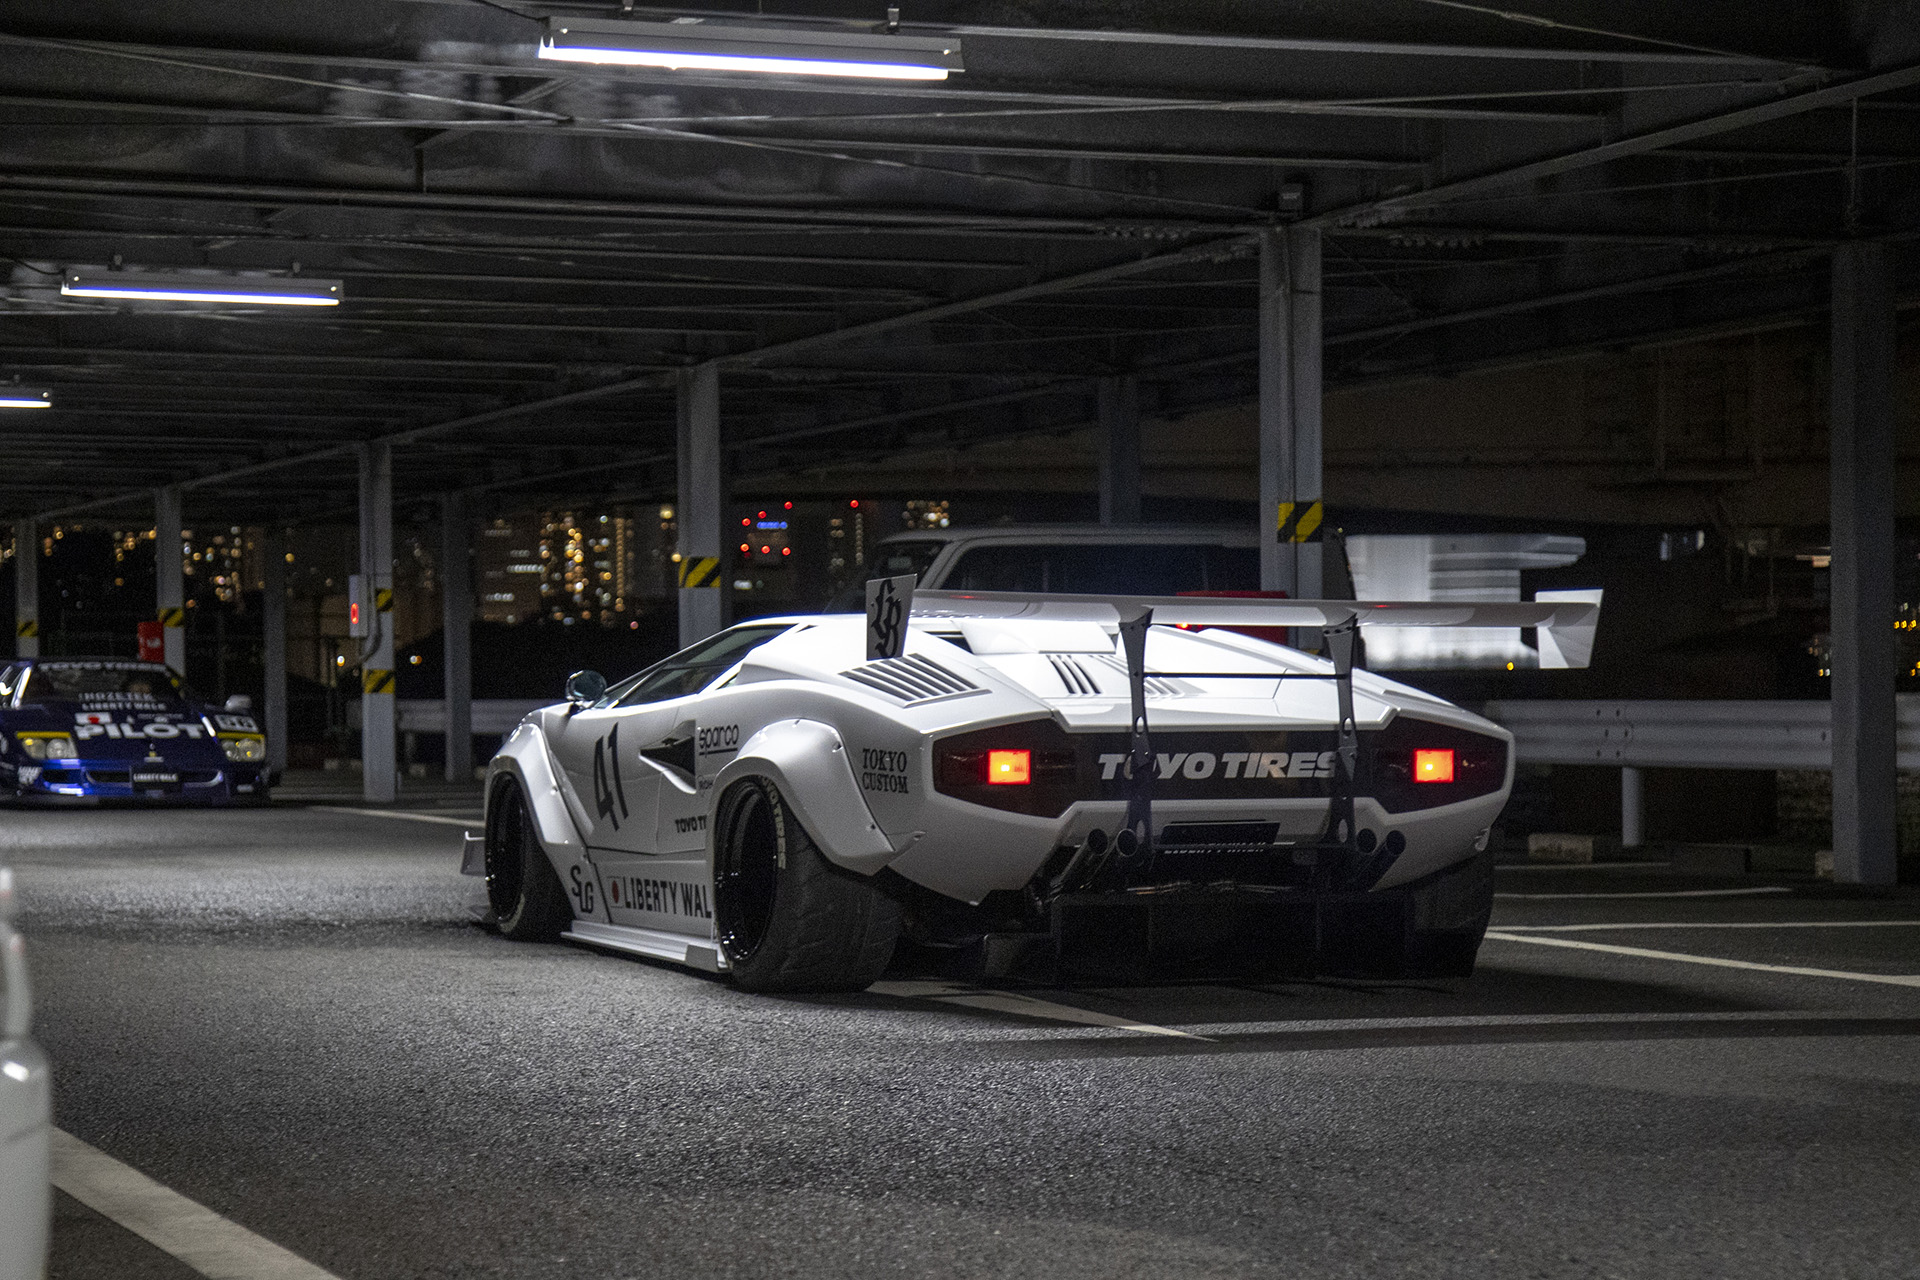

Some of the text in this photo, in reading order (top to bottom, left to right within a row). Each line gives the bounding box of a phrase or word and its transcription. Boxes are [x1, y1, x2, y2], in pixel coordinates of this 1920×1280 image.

[74, 723, 205, 740] PILOT
[699, 724, 739, 754] sparco
[862, 748, 907, 773] TOKYO
[1221, 753, 1338, 779] TIRES
[594, 722, 629, 832] 41
[862, 772, 909, 794] CUSTOM
[675, 816, 698, 833] TOYO
[622, 876, 677, 914] LIBERTY
